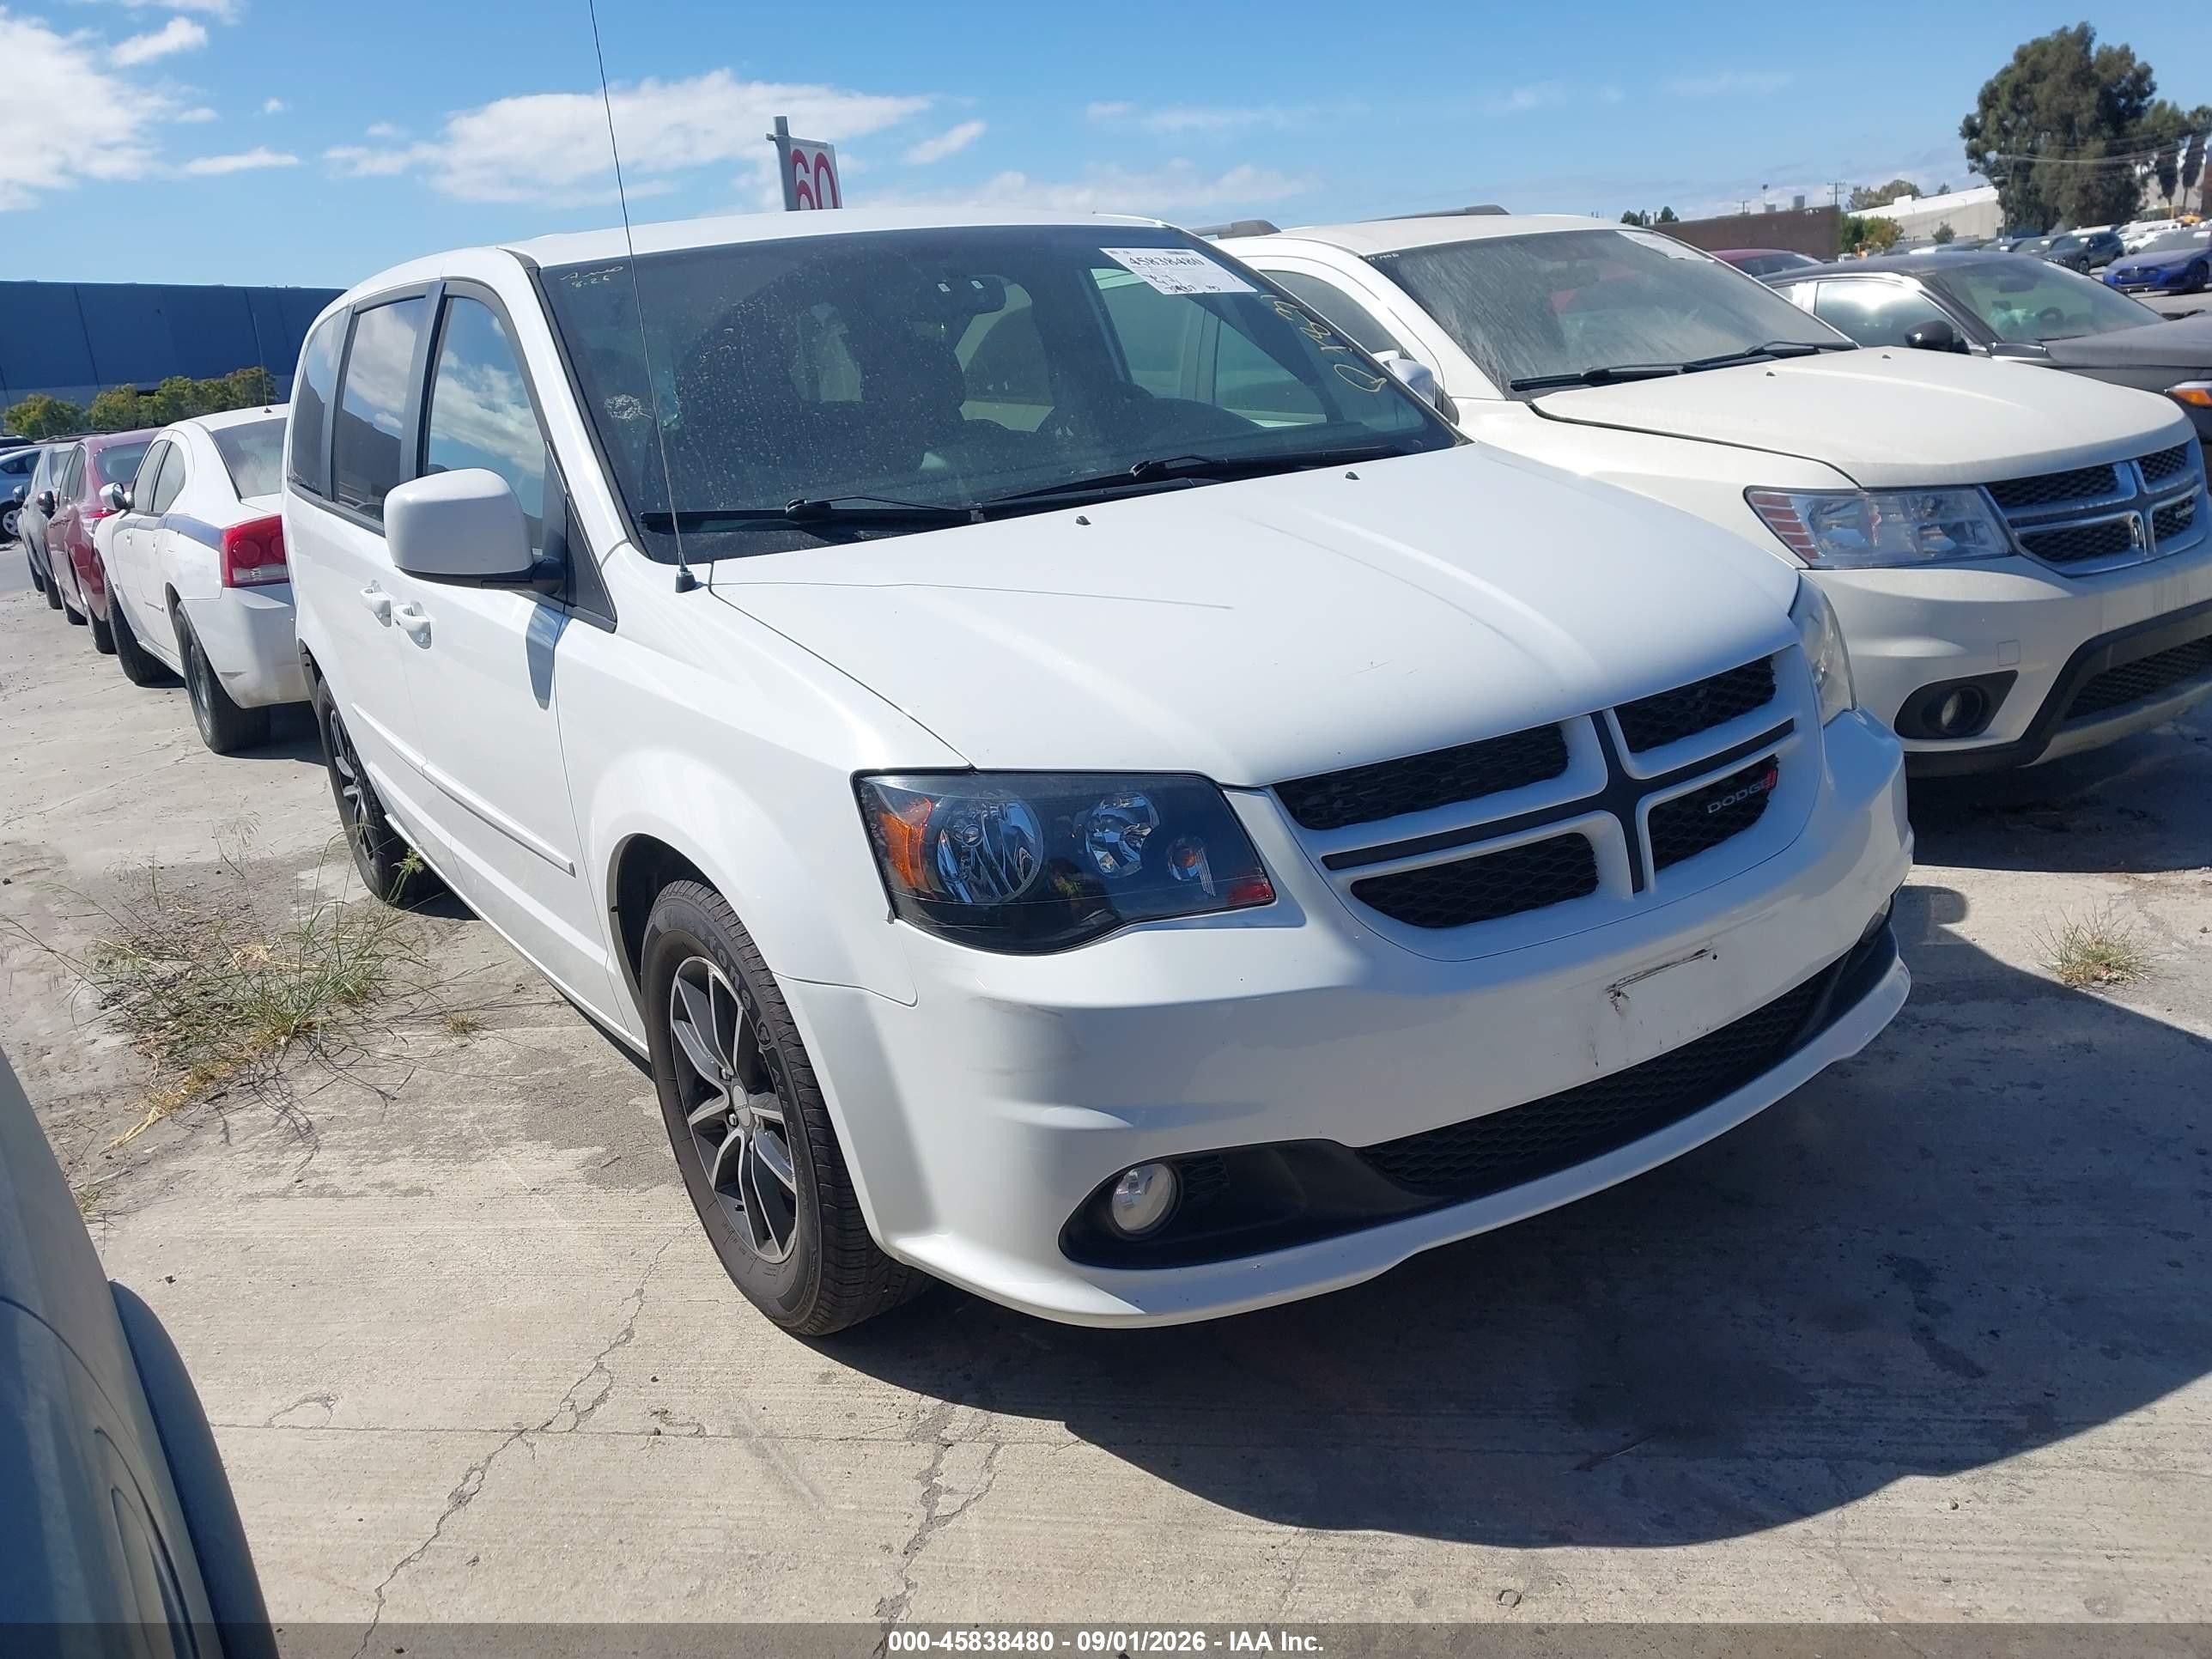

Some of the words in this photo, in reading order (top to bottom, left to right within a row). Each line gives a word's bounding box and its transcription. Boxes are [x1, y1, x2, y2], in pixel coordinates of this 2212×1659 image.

[792, 149, 838, 210] 60
[1128, 257, 1205, 267] 45838480
[1706, 778, 1771, 814] DODGE
